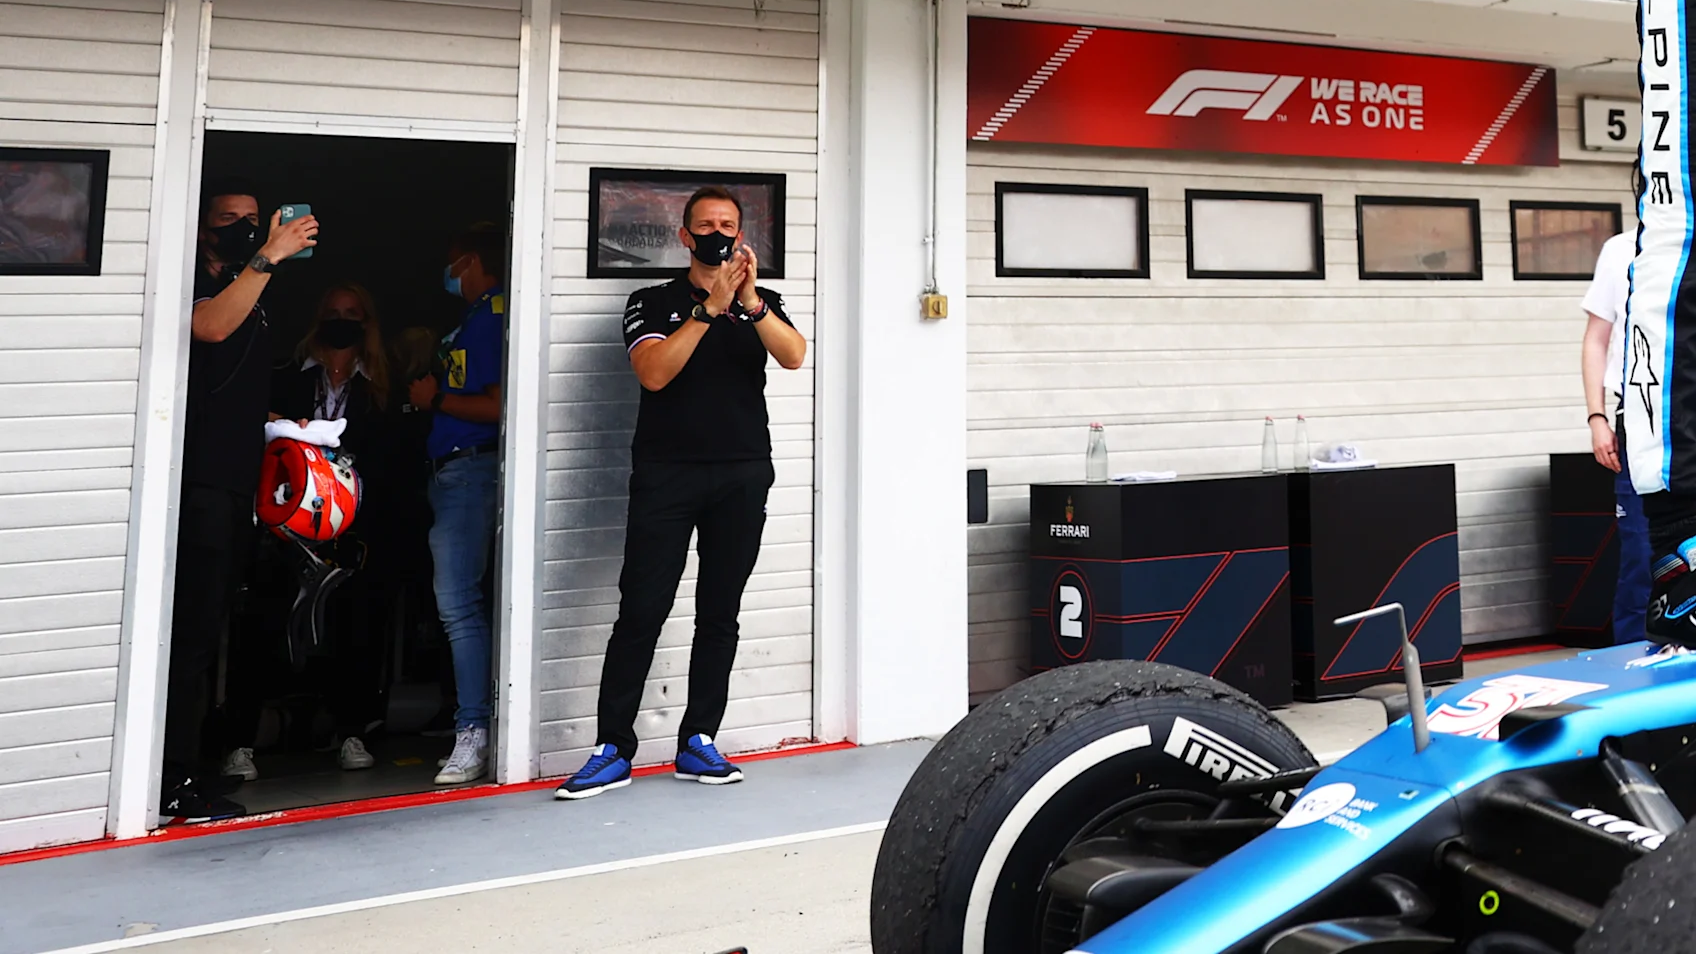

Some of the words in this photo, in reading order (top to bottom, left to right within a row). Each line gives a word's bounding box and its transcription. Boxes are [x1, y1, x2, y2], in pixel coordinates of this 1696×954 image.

[1310, 77, 1354, 101] WE
[1359, 81, 1423, 106] RACE
[1310, 102, 1352, 126] AS
[1362, 106, 1424, 130] ONE
[1607, 109, 1626, 140] 5
[1050, 524, 1089, 538] FERRARI
[1060, 585, 1083, 638] 2
